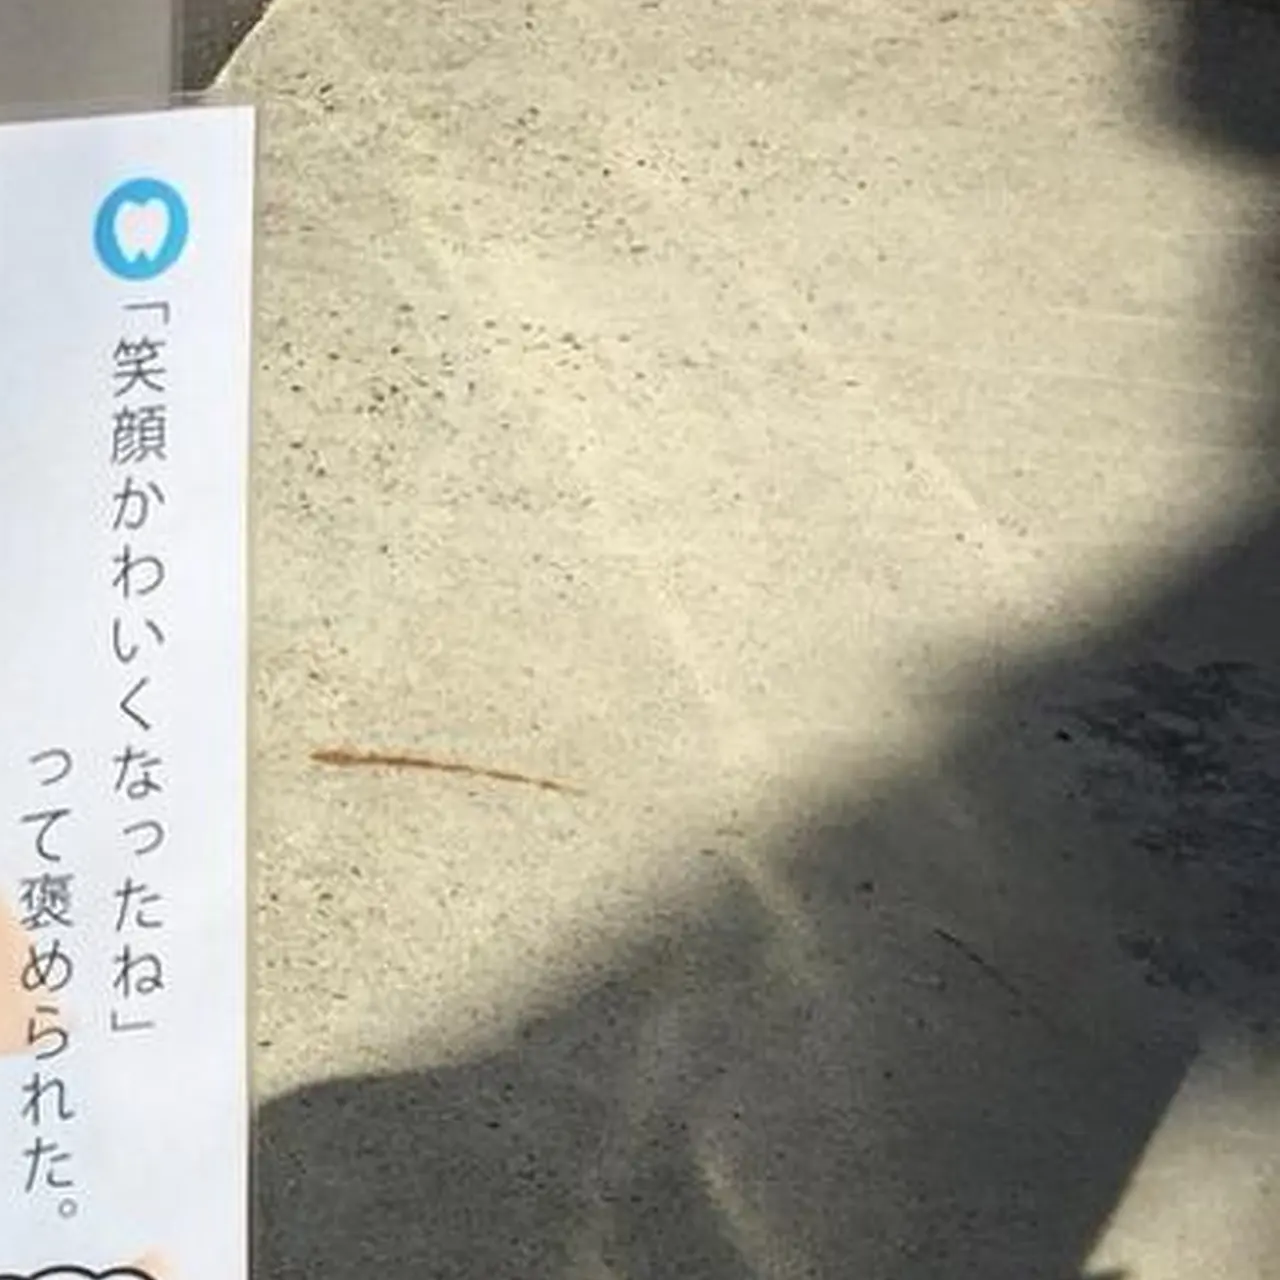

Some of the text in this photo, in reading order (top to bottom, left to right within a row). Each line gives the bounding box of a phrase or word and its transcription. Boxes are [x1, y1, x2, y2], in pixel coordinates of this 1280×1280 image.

[110, 300, 172, 1034] 「笑顔かわいくなったね」
[18, 747, 78, 1221] って褒められた。
